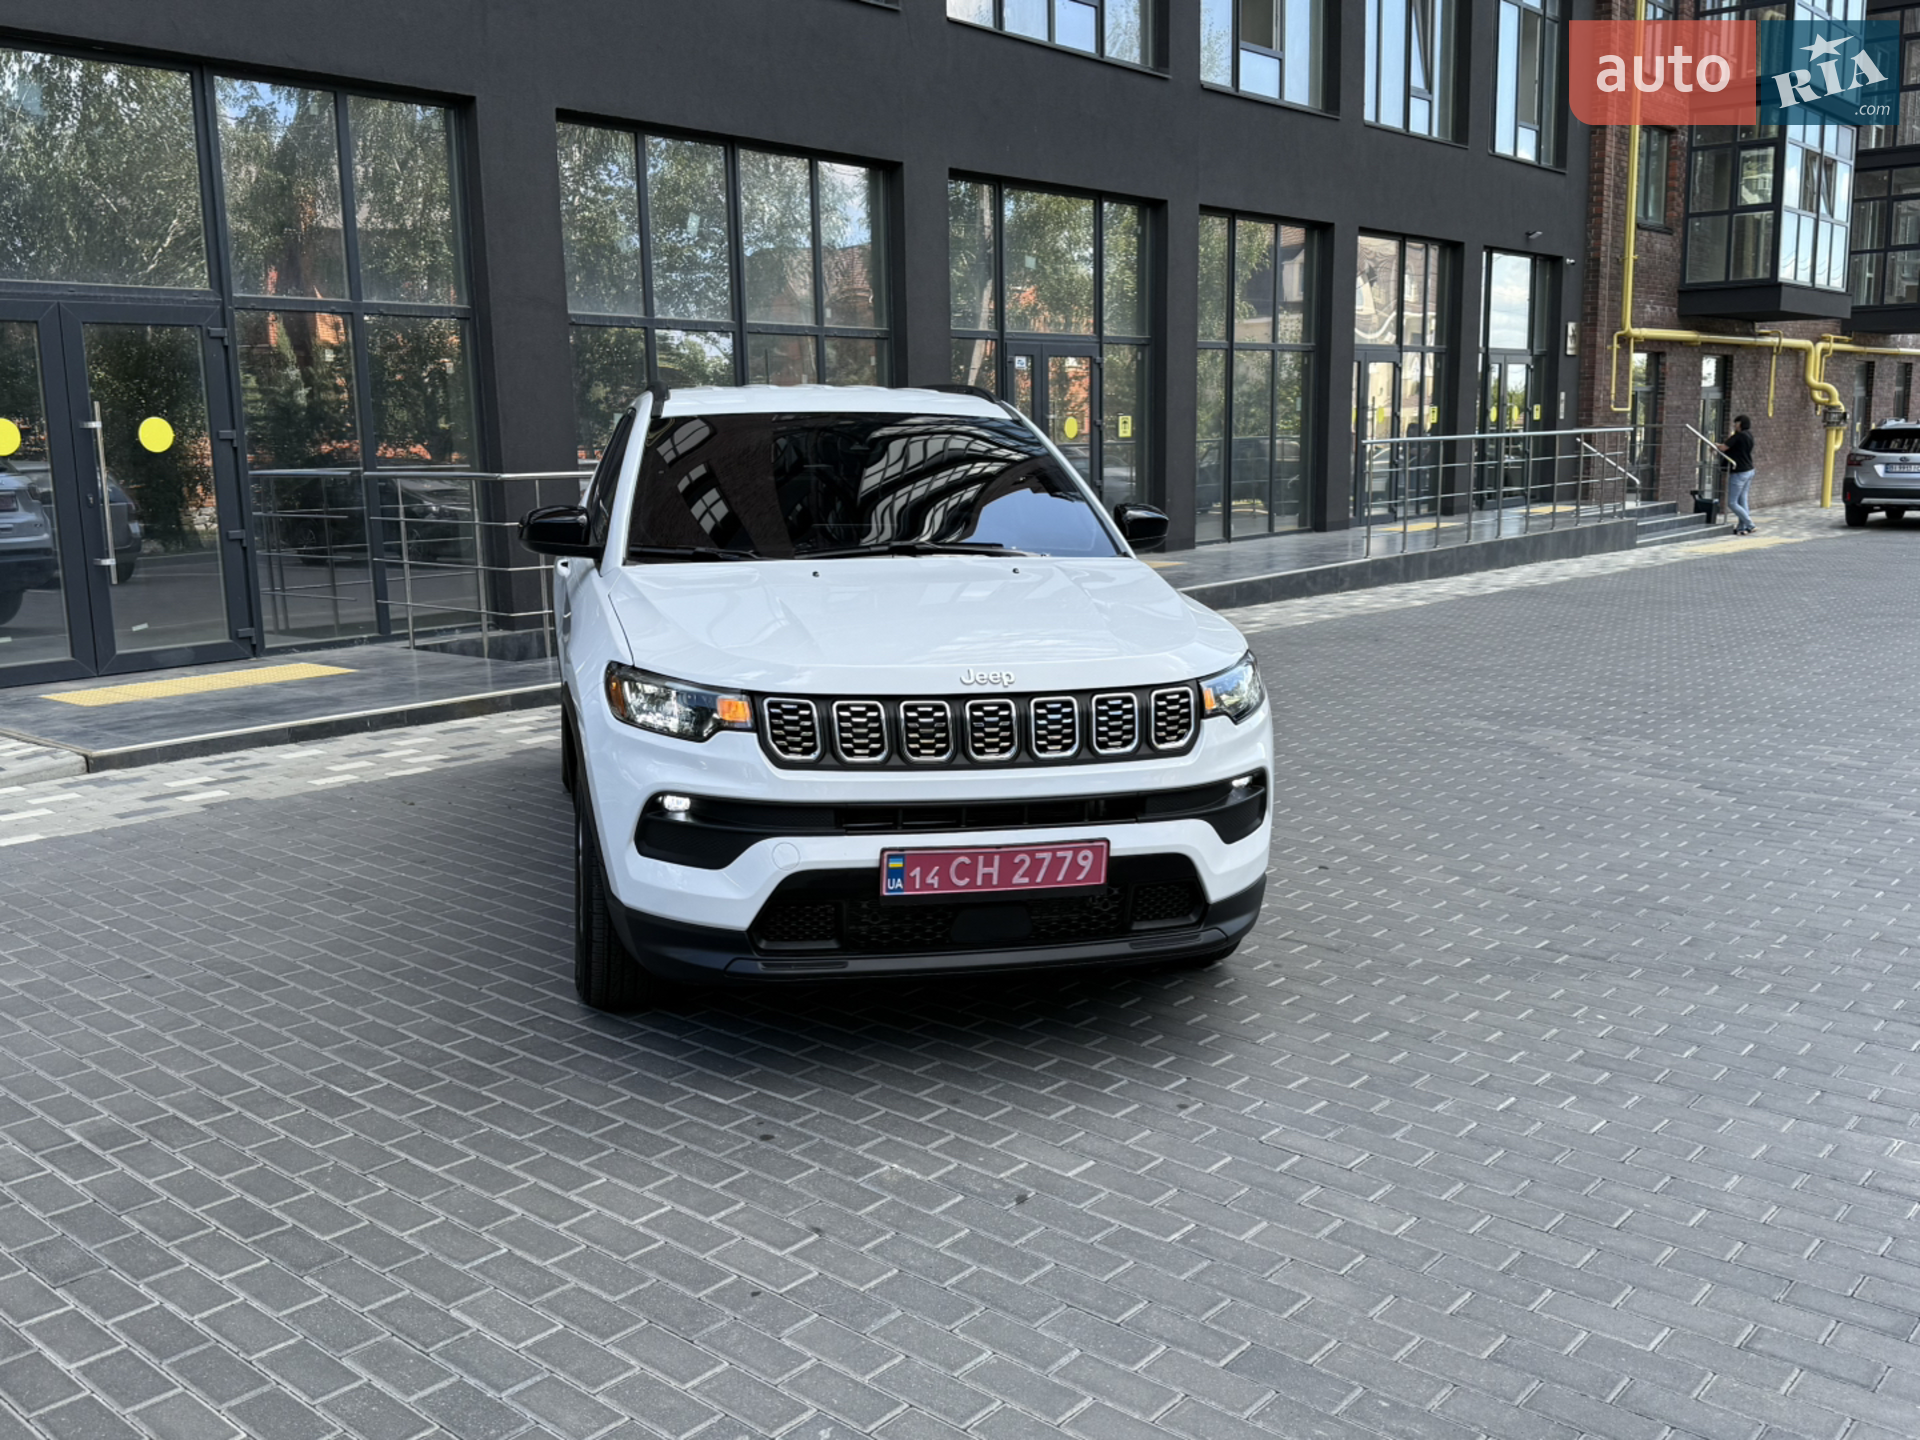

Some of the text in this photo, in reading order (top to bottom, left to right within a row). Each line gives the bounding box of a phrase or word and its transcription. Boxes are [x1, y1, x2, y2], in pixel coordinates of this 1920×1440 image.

[960, 667, 1015, 688] Jeep
[909, 849, 1095, 889] 14 CH 2779
[887, 878, 904, 890] UA
